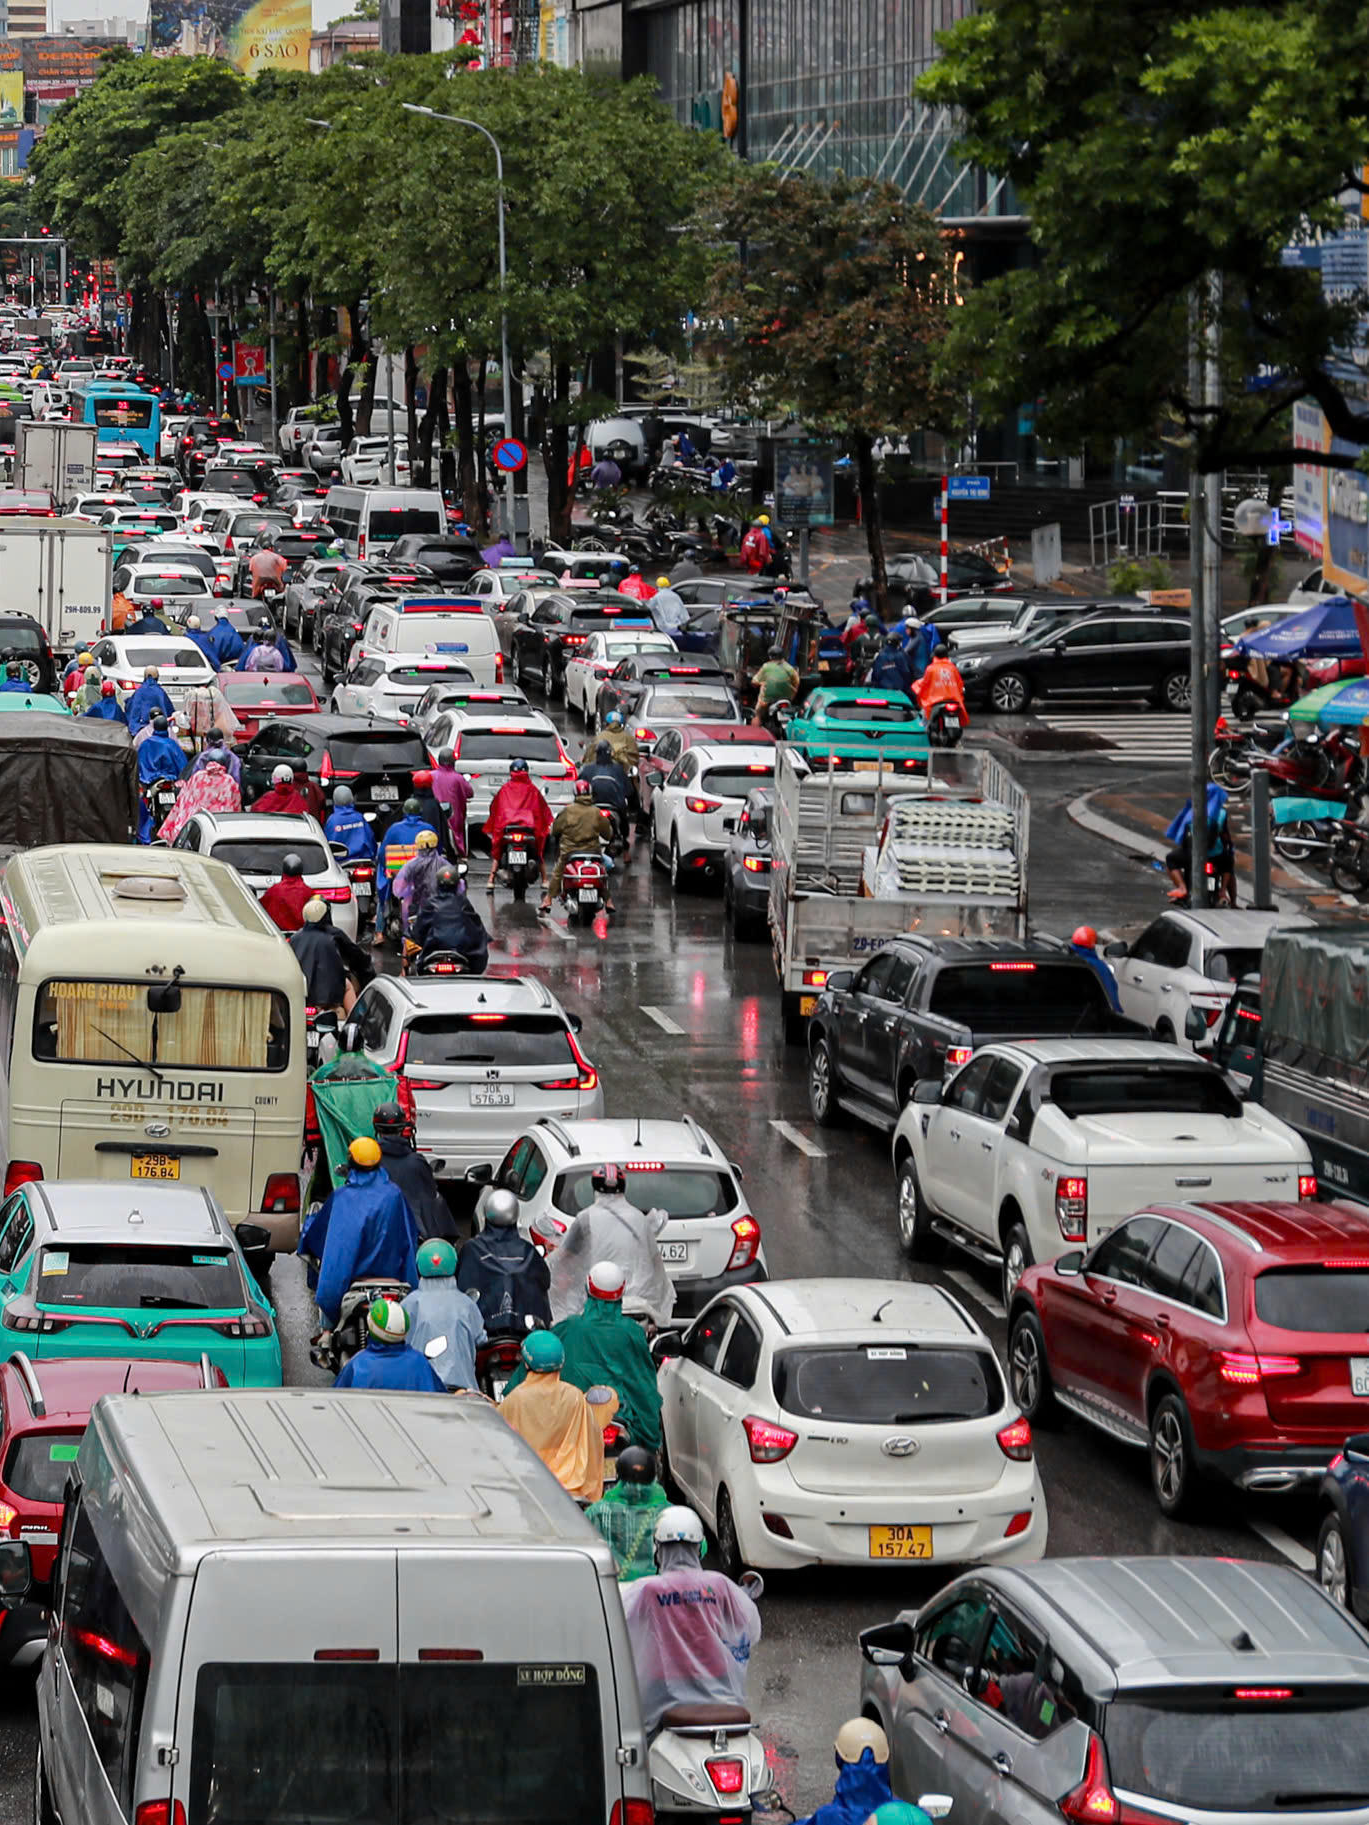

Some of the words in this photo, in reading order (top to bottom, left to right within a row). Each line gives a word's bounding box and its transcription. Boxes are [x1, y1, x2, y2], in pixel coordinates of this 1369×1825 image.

[39, 52, 101, 60] DEMXIN
[249, 43, 260, 57] 6
[264, 43, 299, 58] SAO
[96, 1077, 224, 1102] HYUNDAI
[483, 1083, 501, 1094] 30K
[254, 1096, 279, 1106] COUNTY
[475, 1094, 511, 1105] 576.39
[145, 1154, 168, 1167] 29B
[137, 1166, 175, 1179] 176.84
[887, 1527, 914, 1541] 30A
[878, 1542, 925, 1557] 157.47
